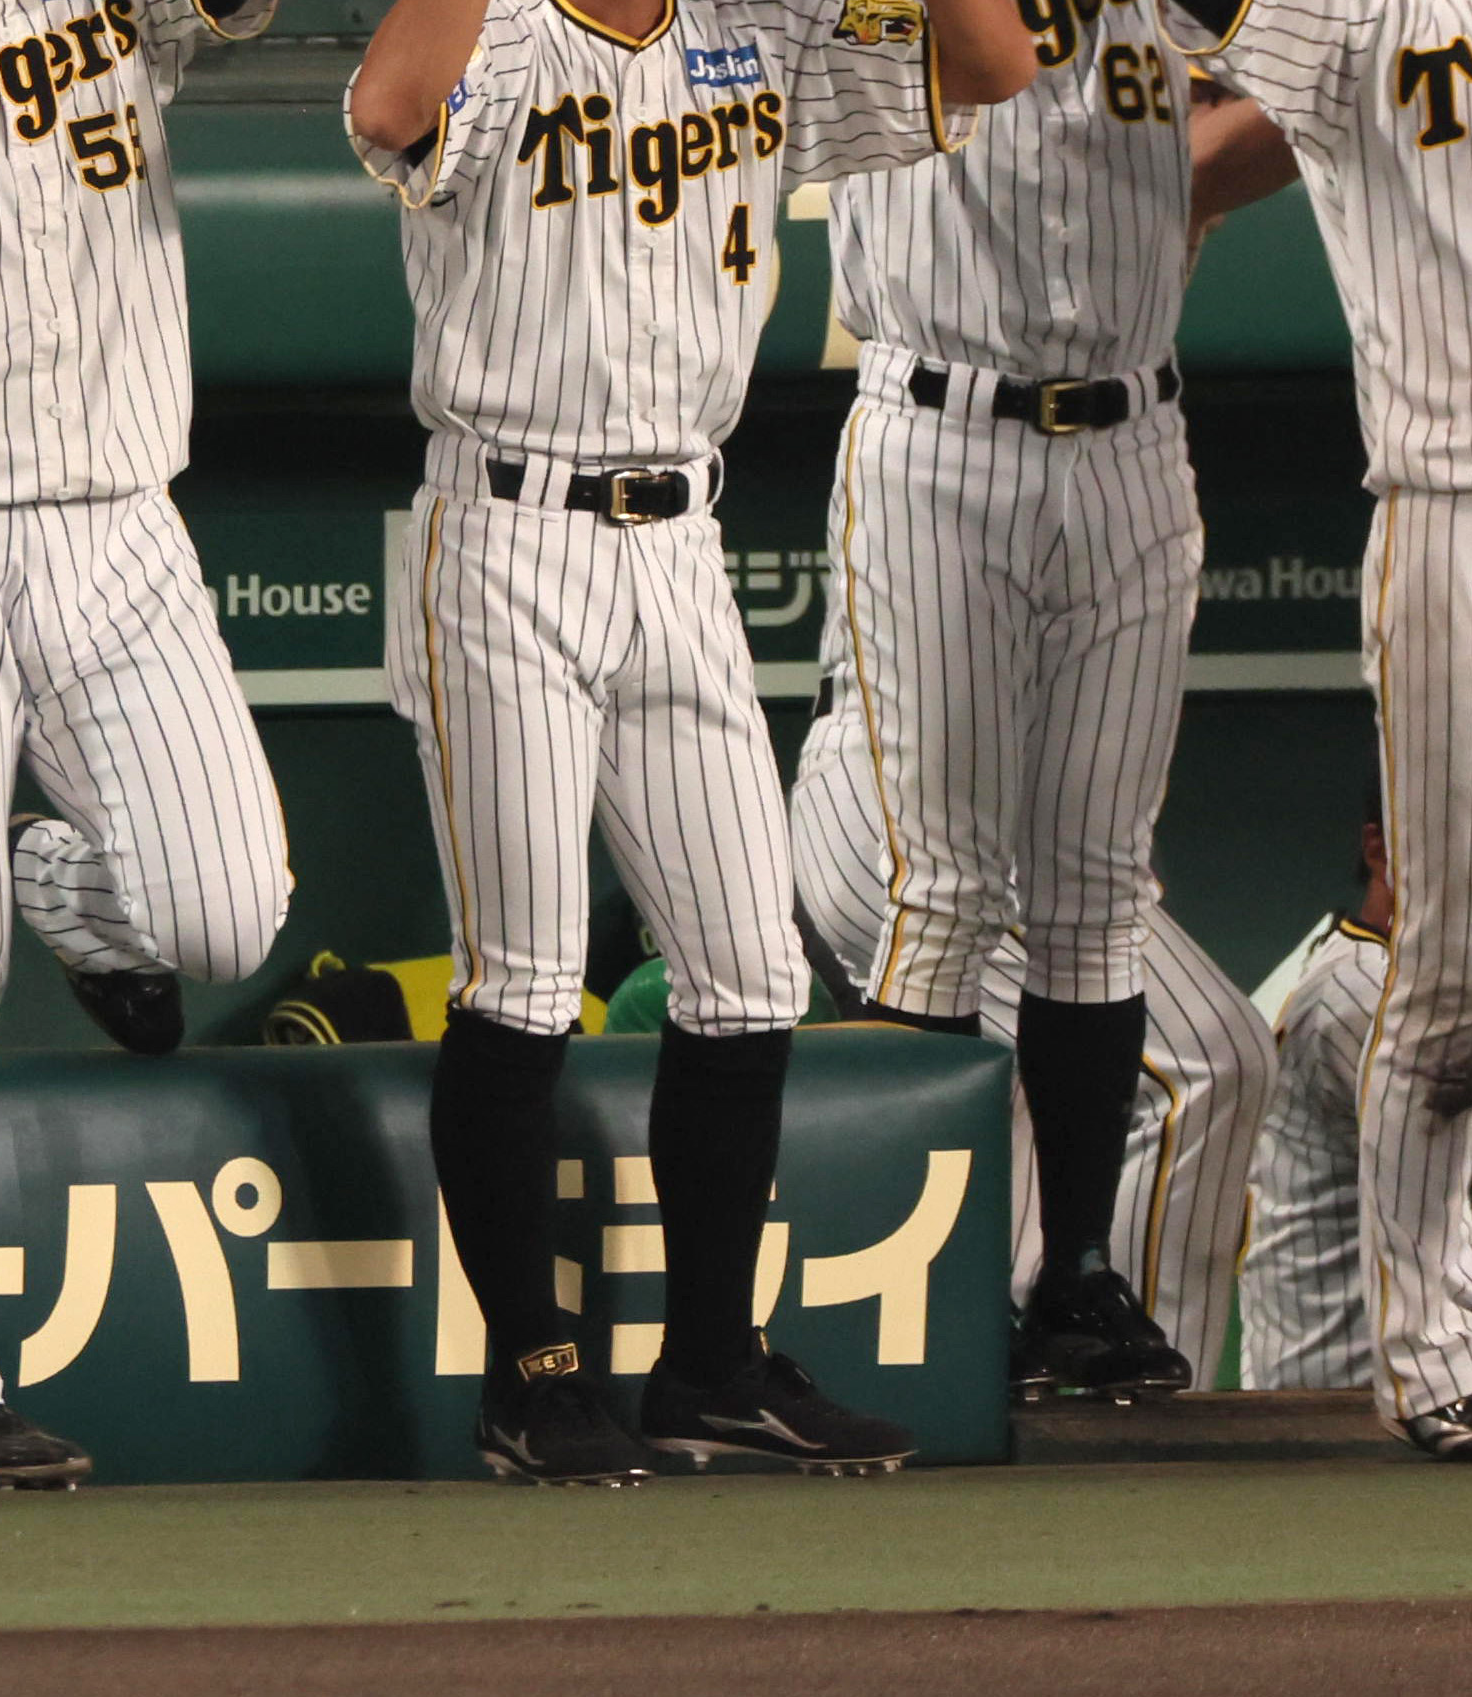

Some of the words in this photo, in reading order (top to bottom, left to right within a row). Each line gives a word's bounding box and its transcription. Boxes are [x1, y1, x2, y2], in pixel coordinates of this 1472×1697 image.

[517, 89, 787, 227] Tigers
[719, 203, 757, 287] 4
[226, 574, 372, 618] House
